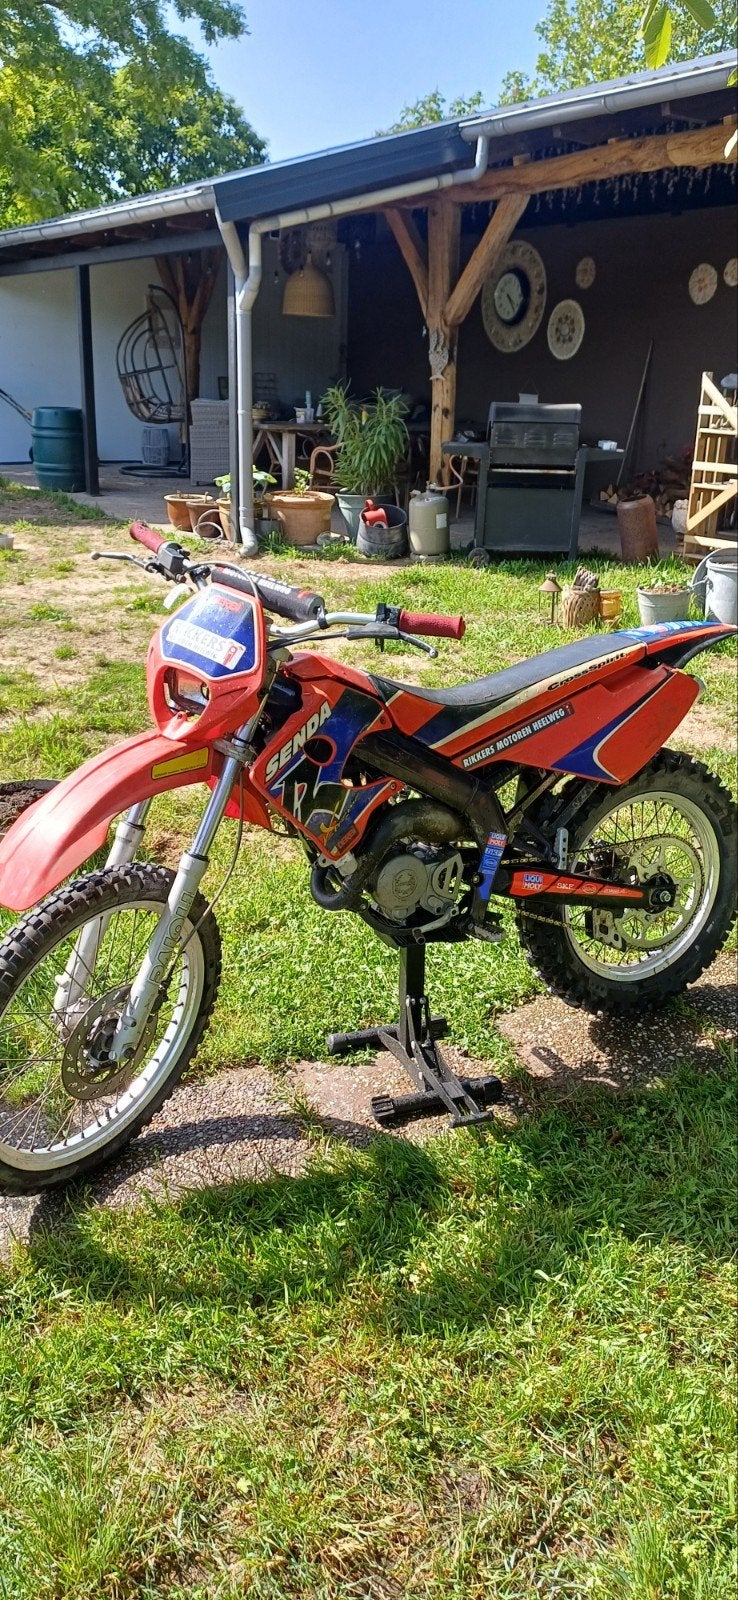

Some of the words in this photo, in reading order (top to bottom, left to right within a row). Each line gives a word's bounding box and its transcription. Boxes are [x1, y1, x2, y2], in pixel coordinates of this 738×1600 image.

[265, 700, 332, 783] SENDA
[463, 745, 495, 768] RIKKERS
[496, 726, 532, 751] MOTOREN
[532, 707, 565, 731] HEELWEG
[523, 881, 543, 890] MOLY
[524, 873, 543, 882] LIQUI
